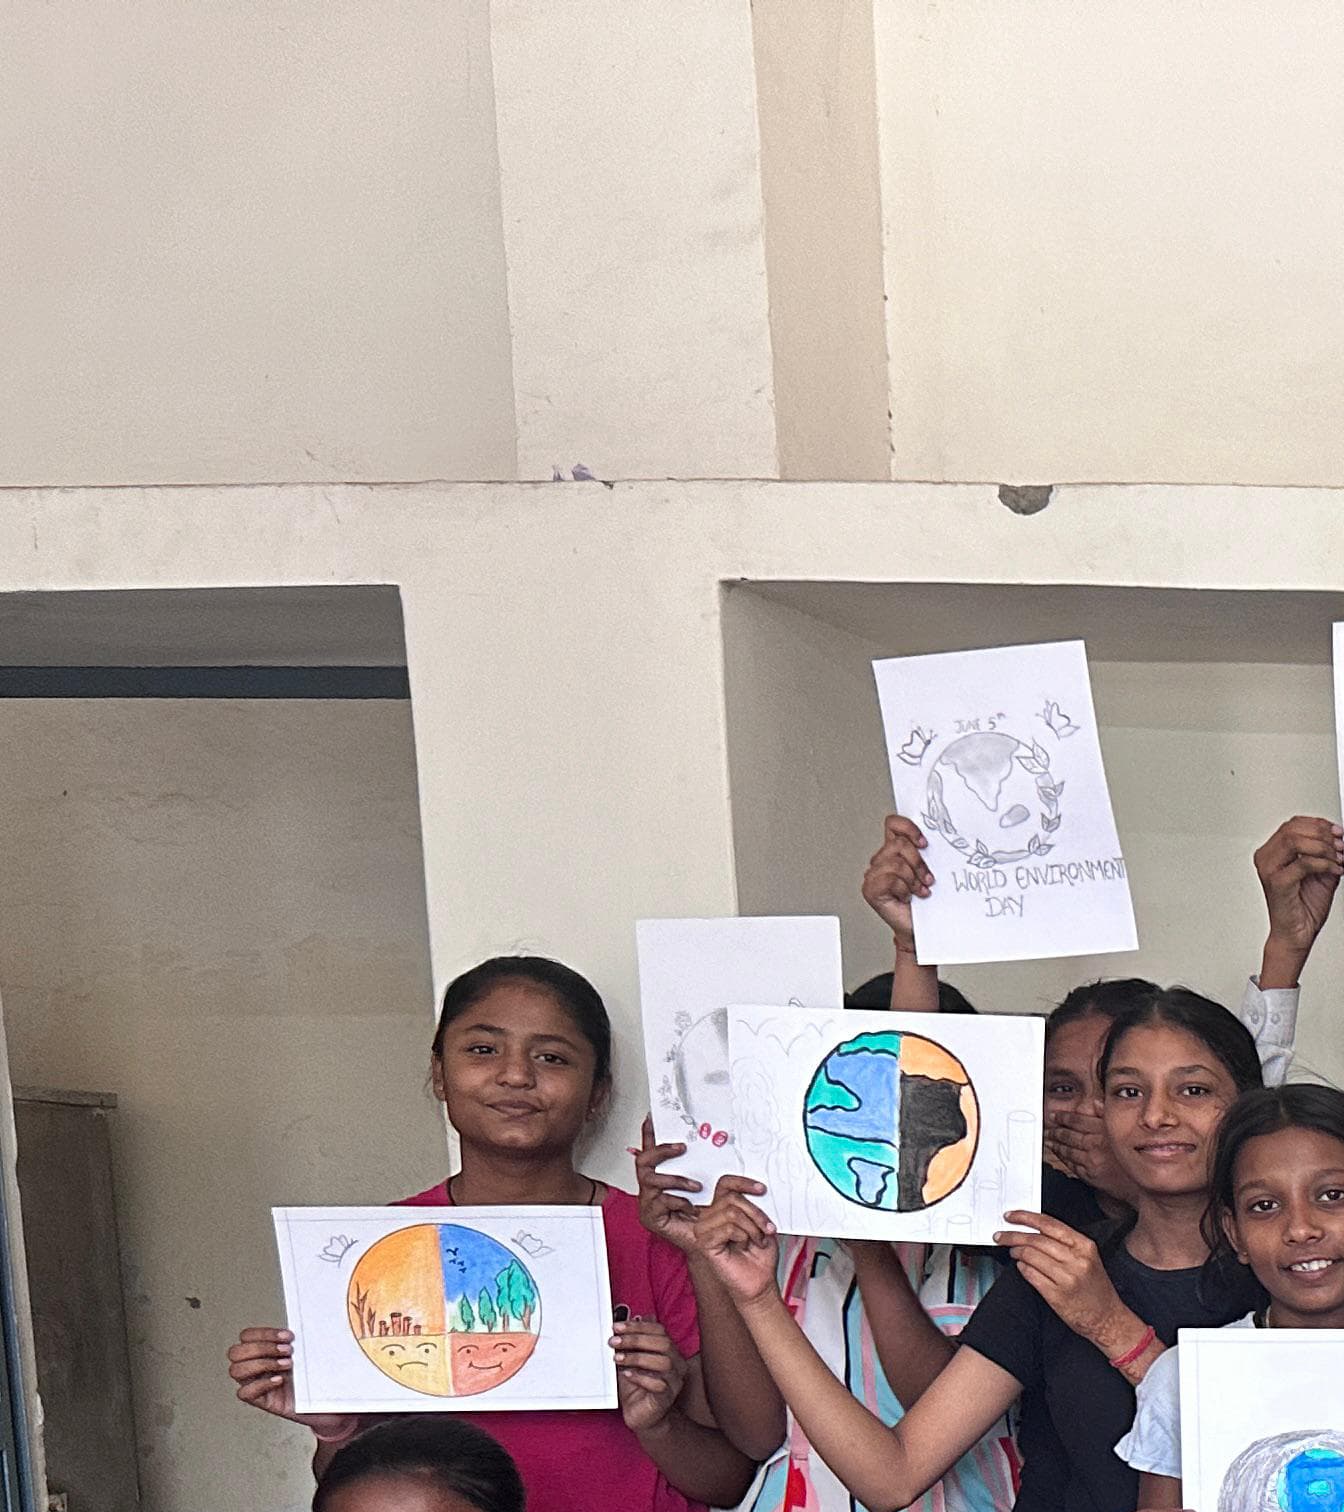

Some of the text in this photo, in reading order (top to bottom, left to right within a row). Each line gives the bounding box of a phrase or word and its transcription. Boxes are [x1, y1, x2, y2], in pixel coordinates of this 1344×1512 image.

[952, 856, 1127, 896] WORLD ENVIRONMENT
[985, 894, 1024, 918] DAY
